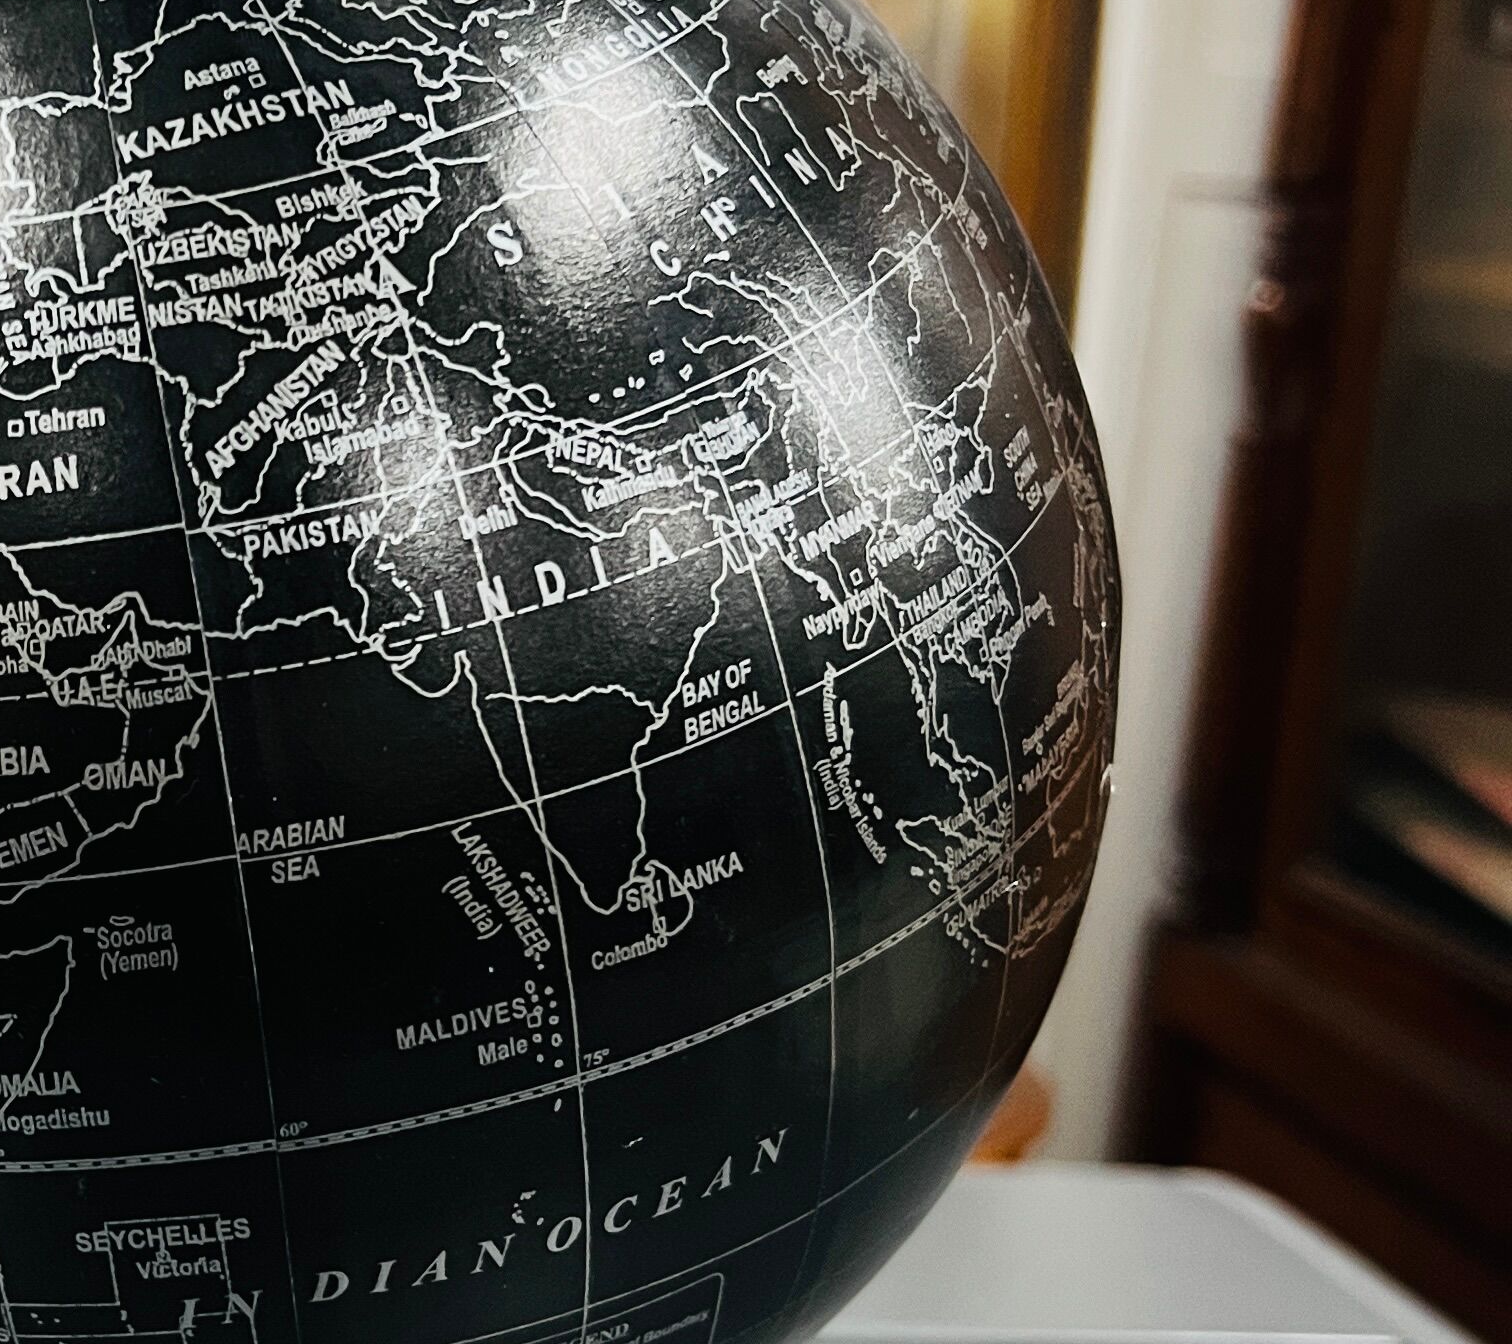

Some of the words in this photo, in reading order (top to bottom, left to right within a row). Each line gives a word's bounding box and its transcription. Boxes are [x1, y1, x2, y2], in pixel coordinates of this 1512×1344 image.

[537, 6, 695, 94] MONGOLIA
[184, 56, 260, 91] Astana
[116, 79, 356, 164] KAZAKHSTAN
[275, 178, 368, 219] Bishkek
[138, 222, 302, 268] UZBEKISTAN
[24, 406, 106, 436] Tehran
[205, 339, 345, 479] AFGHANISTAN
[274, 405, 344, 444] Kabul
[302, 416, 421, 466] Islamabad
[556, 437, 624, 473] NEPAL
[243, 509, 381, 561] PAKISTAN
[457, 503, 518, 540] Delhi
[434, 527, 679, 630] INDIA
[902, 565, 971, 625] THAILAND
[142, 635, 192, 660] Dhabi
[126, 681, 194, 711] Muscat
[682, 671, 721, 708] BAY
[725, 658, 754, 687] OF
[683, 692, 766, 744] BENGAL
[84, 758, 167, 792] OMAN
[813, 758, 846, 811] (India)
[237, 814, 346, 855] ARABIAN
[854, 813, 888, 865] Islands
[271, 855, 321, 885] SEA
[450, 820, 552, 956] LAKSHADWEEP
[625, 878, 666, 914] SRI
[668, 850, 745, 899] LANKA
[441, 873, 504, 941] (India)
[96, 921, 174, 950] Socotra
[590, 929, 669, 972] Colombo
[99, 942, 179, 981] (Yemen)
[395, 996, 529, 1050] MALDIVES
[477, 1037, 529, 1066] Male
[278, 1119, 309, 1138] 60°
[545, 1128, 790, 1255] OCEAN
[75, 1217, 252, 1253] SEYCHELLES
[136, 1255, 223, 1280] Victoria
